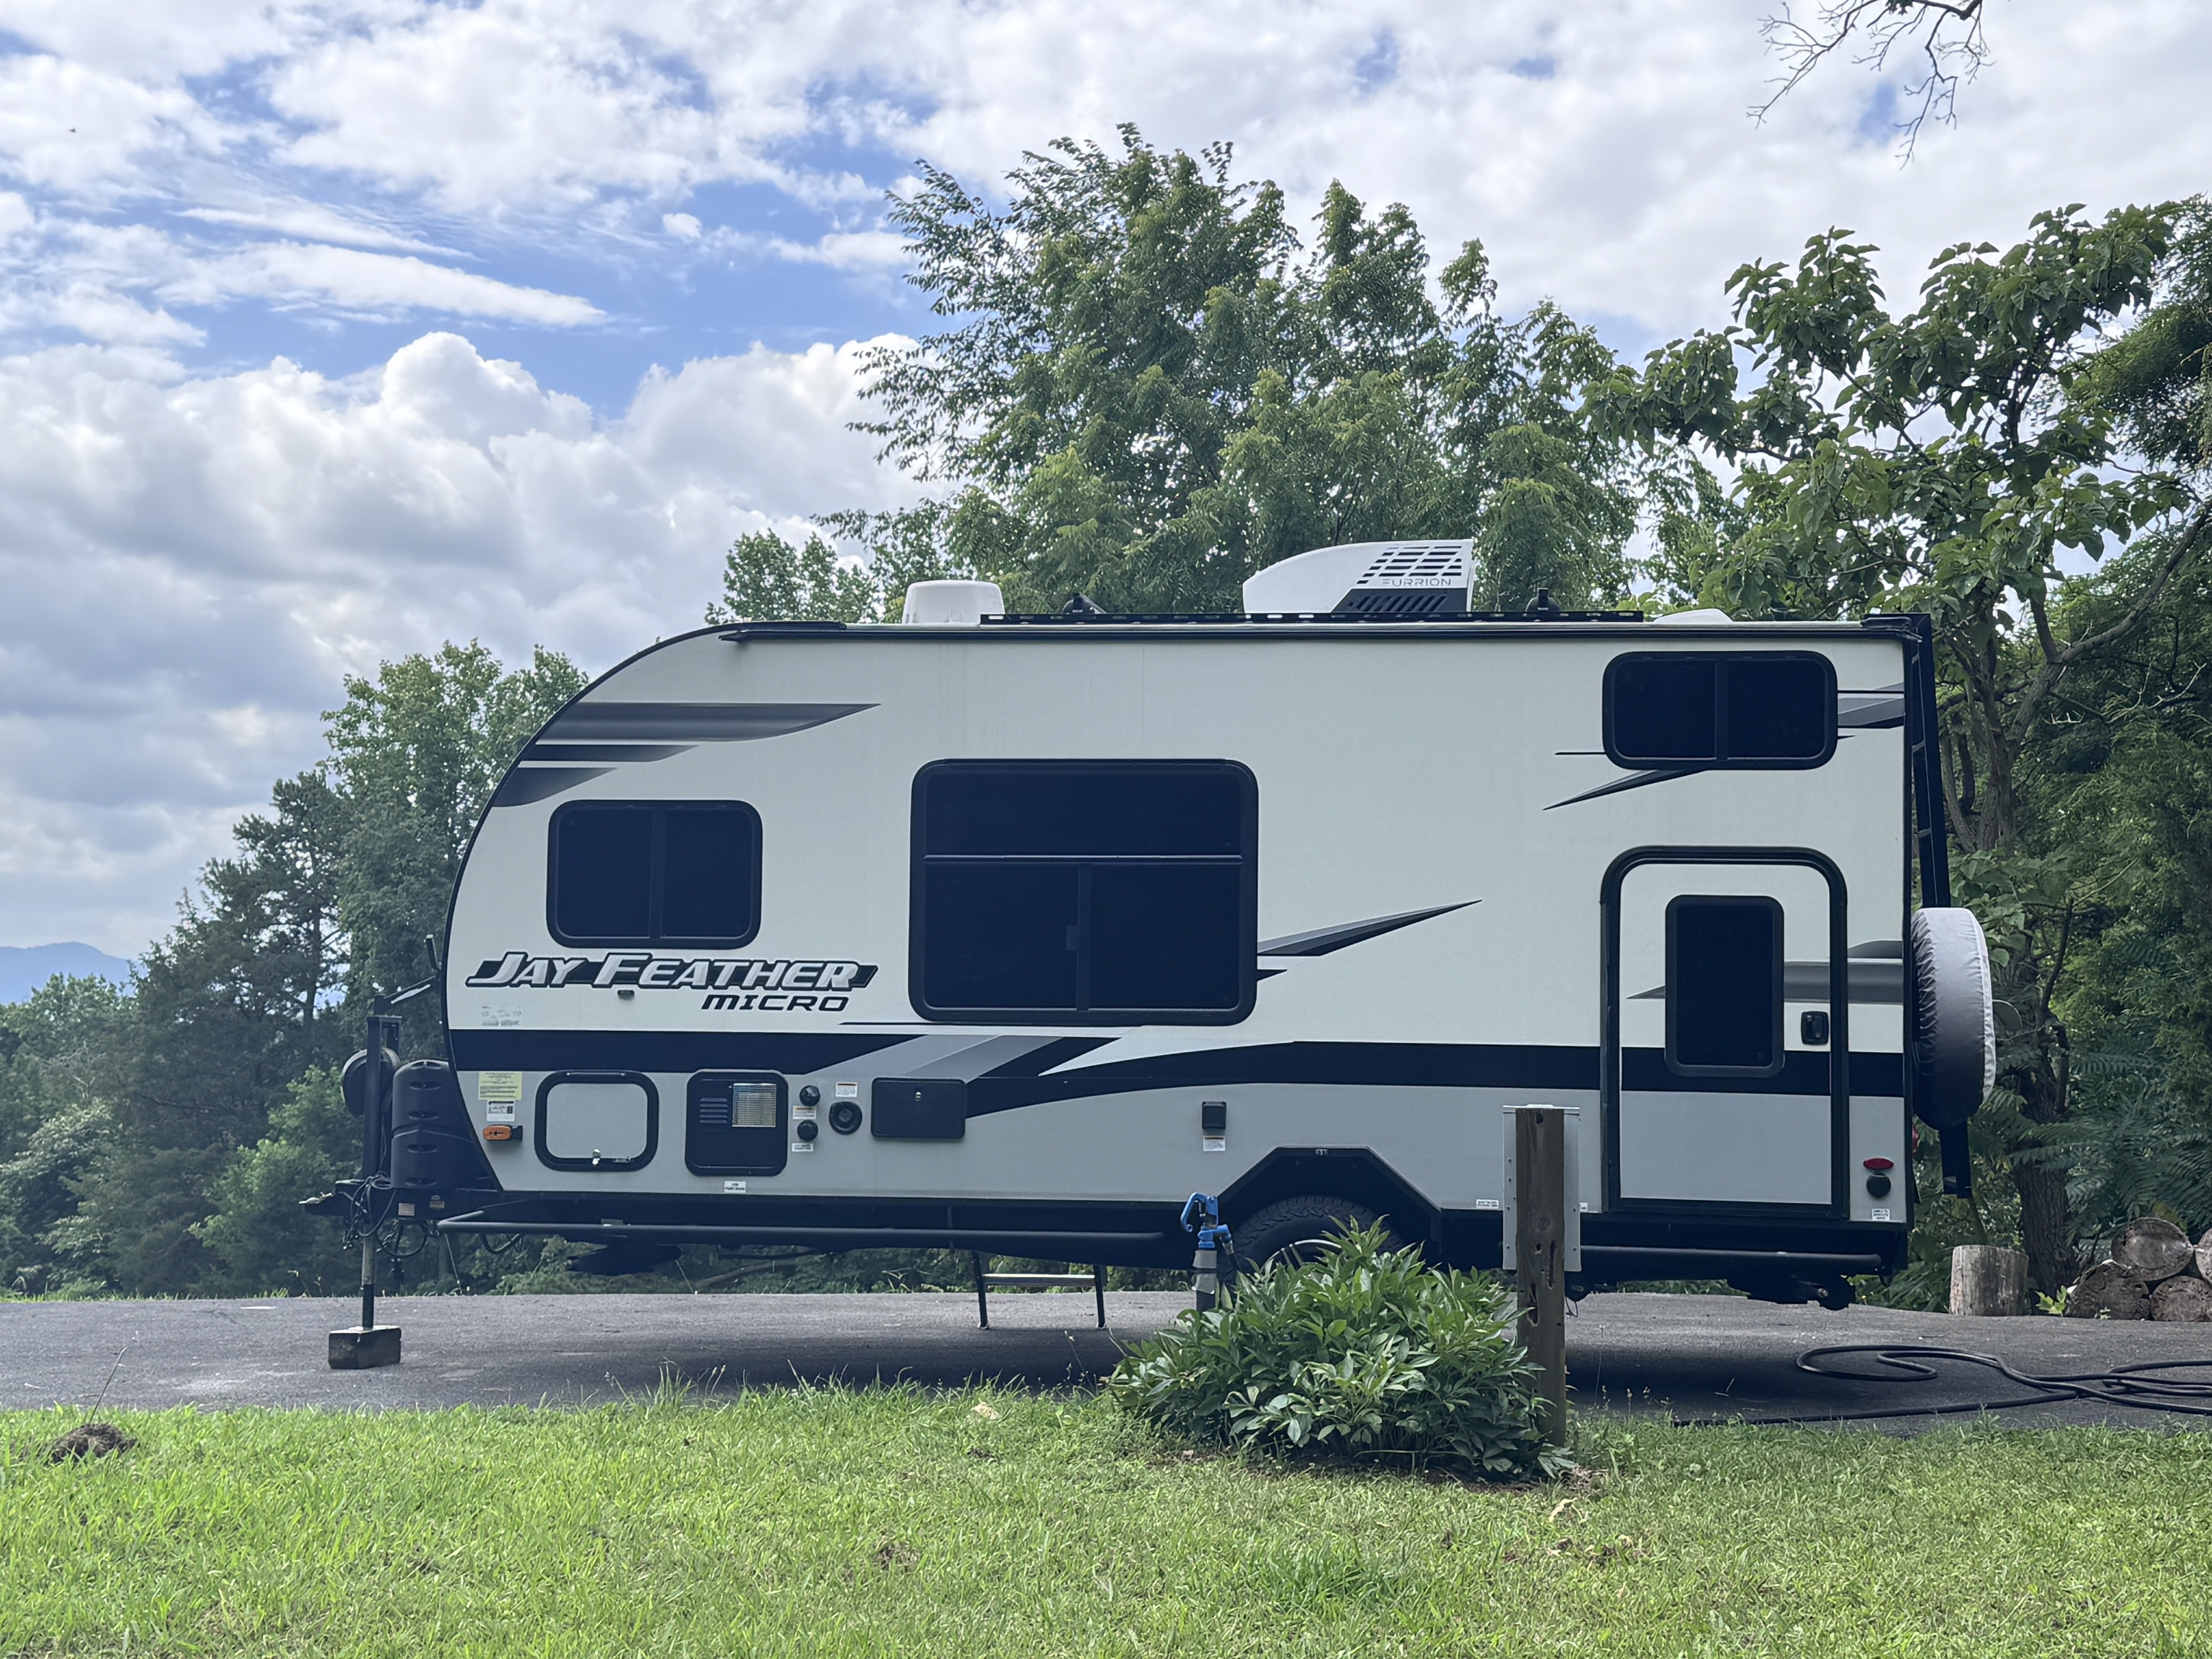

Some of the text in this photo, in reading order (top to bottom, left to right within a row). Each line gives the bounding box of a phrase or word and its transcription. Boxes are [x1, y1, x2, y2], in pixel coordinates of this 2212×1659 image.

[1382, 578, 1451, 587] FURRION
[466, 953, 859, 989] JAY FEATHER
[701, 994, 849, 1012] MICRO
